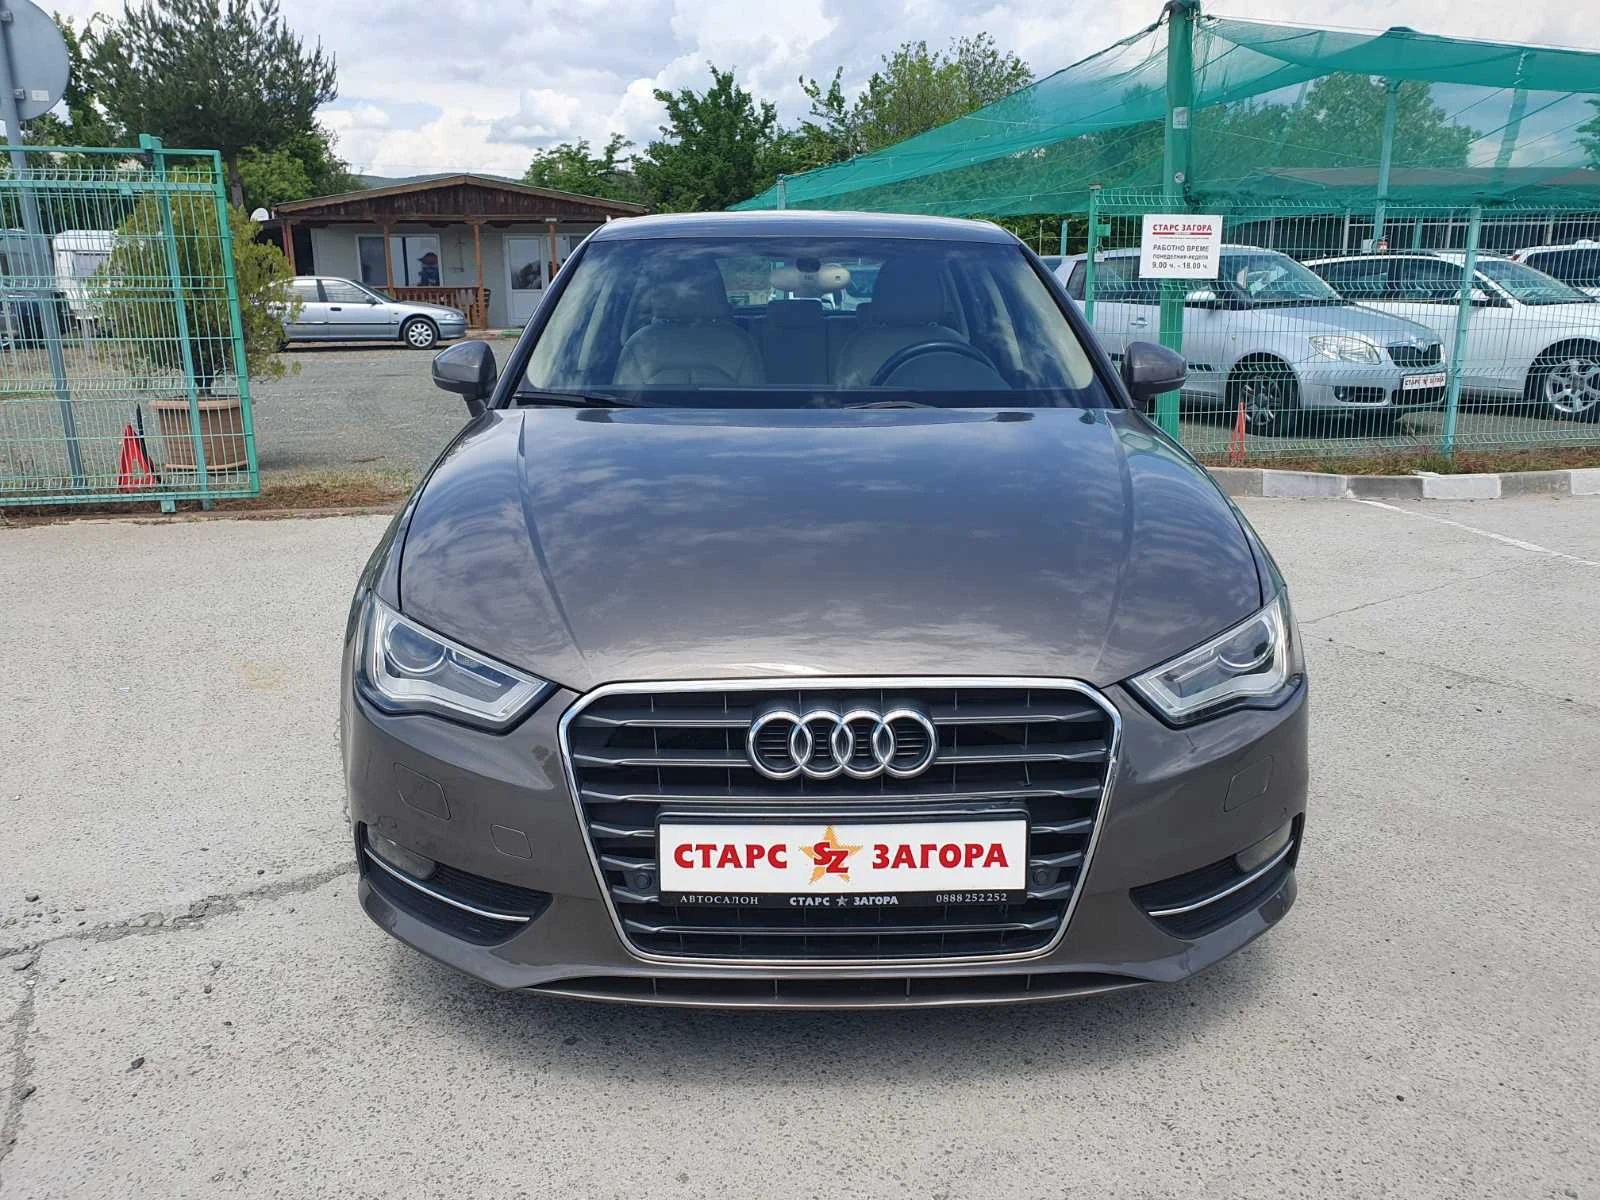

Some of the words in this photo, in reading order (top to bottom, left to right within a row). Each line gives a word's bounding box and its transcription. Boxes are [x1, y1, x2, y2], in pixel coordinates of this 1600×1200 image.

[674, 843, 788, 869] СТАРС
[813, 842, 849, 874] SZ
[872, 842, 1009, 870] ЗАГОРА
[680, 895, 758, 904] АВТОСАЛОН
[790, 896, 830, 906] СТАРС
[853, 896, 899, 906] ЗАГОРА
